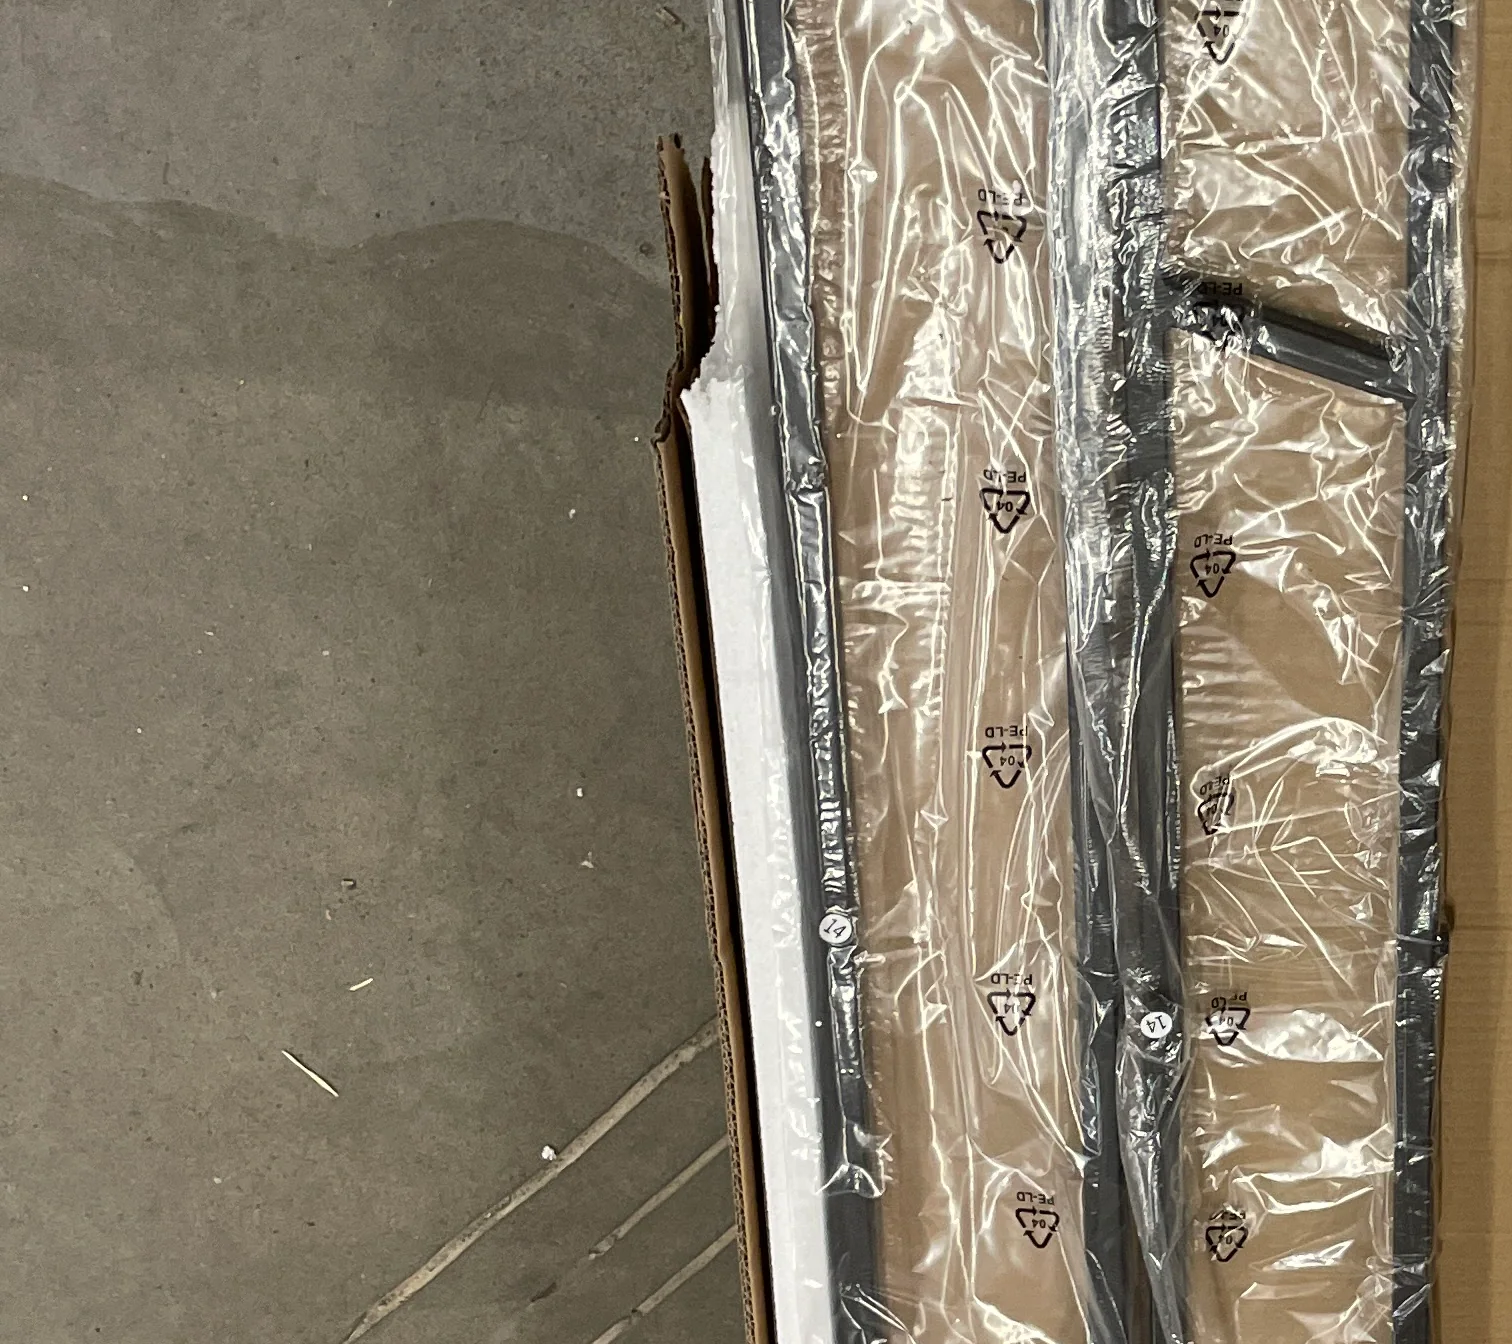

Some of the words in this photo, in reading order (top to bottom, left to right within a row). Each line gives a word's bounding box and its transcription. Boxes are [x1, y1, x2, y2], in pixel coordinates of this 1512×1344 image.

[1213, 23, 1231, 38] 04
[1200, 281, 1244, 296] PE-LD
[996, 500, 1014, 513] 04
[1193, 533, 1234, 548] PE-LD
[1204, 562, 1221, 575] 04
[984, 725, 1029, 740] PE-LD
[999, 755, 1016, 767] 04
[1199, 776, 1231, 796] PE-LD
[822, 918, 847, 938] 14
[1145, 1014, 1167, 1034] 14
[1016, 1190, 1056, 1207] PE-LD
[1031, 1219, 1047, 1230] 04
